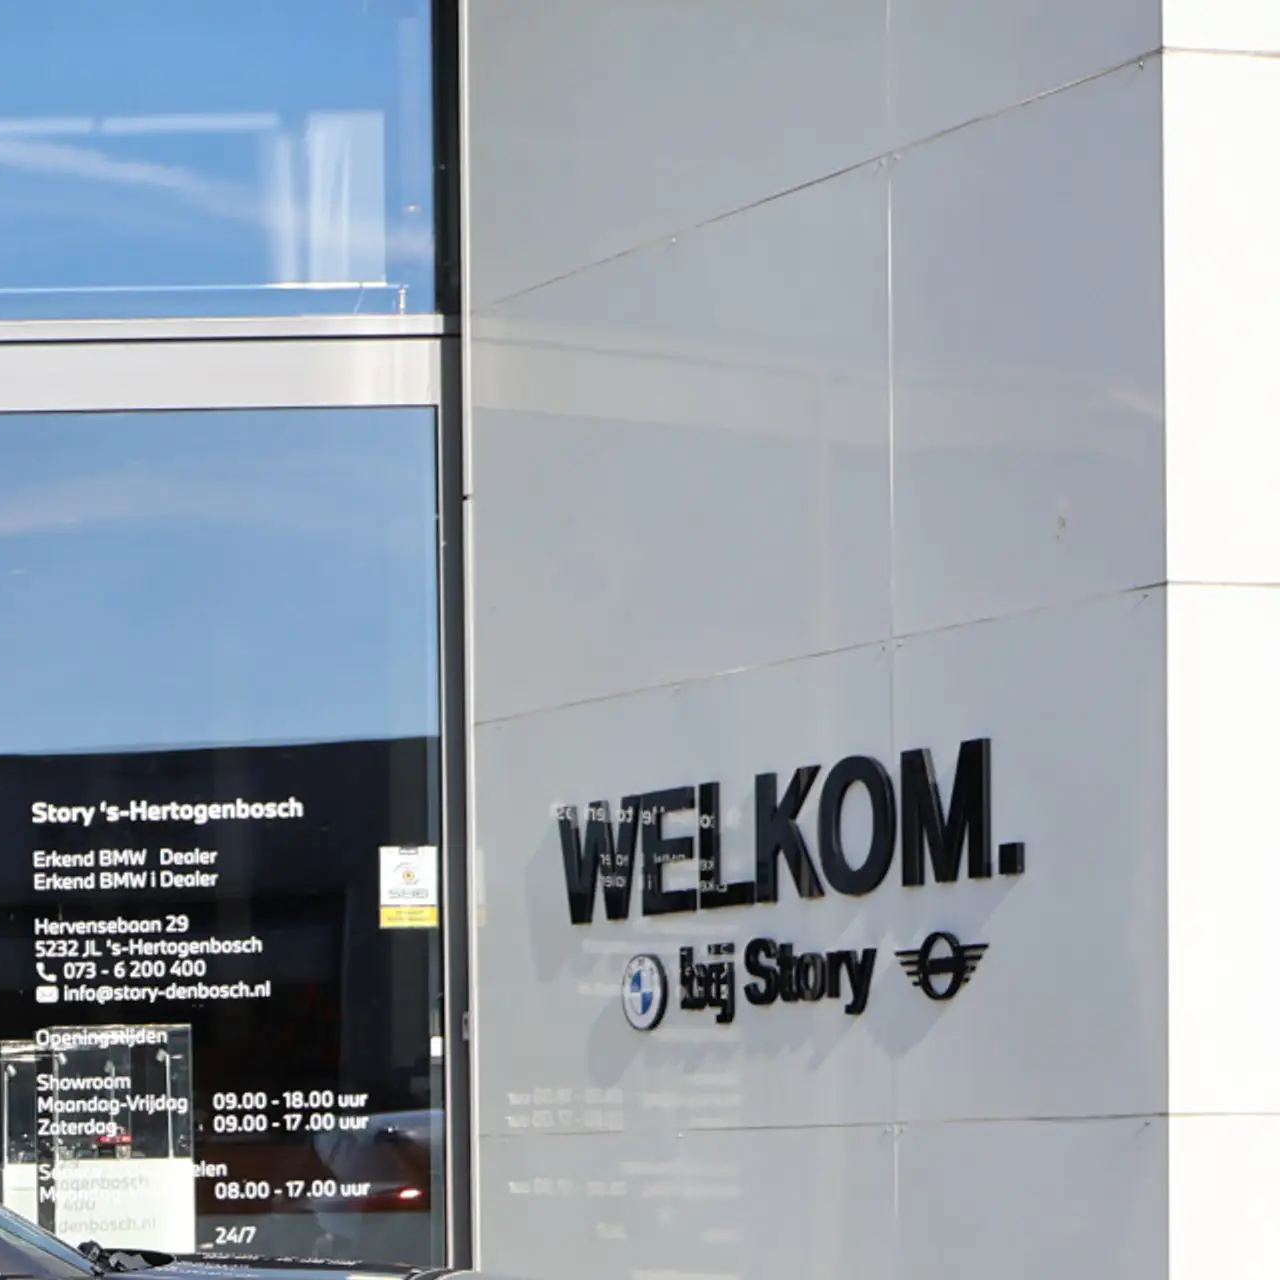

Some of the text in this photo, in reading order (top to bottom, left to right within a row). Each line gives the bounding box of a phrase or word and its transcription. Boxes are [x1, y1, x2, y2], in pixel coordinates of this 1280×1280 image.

[31, 801, 96, 827] Story
[556, 738, 1026, 926] WELKOM.
[32, 847, 219, 869] Erkend BMW Dealer
[33, 869, 219, 891] Erkend BMW i Dealer
[34, 914, 190, 936] Hervensebaan 29
[34, 939, 80, 958] 5232
[81, 939, 103, 959] JL
[63, 961, 97, 980] 073
[113, 960, 127, 979] 6
[129, 959, 166, 979] 200
[169, 958, 207, 978] 400
[63, 980, 271, 1004] info@story-denbosch.nl
[679, 938, 877, 1024] bij Story
[36, 1028, 168, 1049] Openingstijden
[36, 1074, 131, 1091] Showroom
[38, 1095, 189, 1117] Maandag-Vrijdag
[212, 1091, 268, 1111] 09.00
[282, 1089, 335, 1109] 18.00
[337, 1093, 369, 1108] uur
[38, 1118, 118, 1137] Zaterdag
[213, 1113, 268, 1133] 09.00
[338, 1115, 370, 1131] uur
[214, 1180, 271, 1200] 08.00
[340, 1182, 372, 1197] uur
[215, 1225, 257, 1245] 24/7
